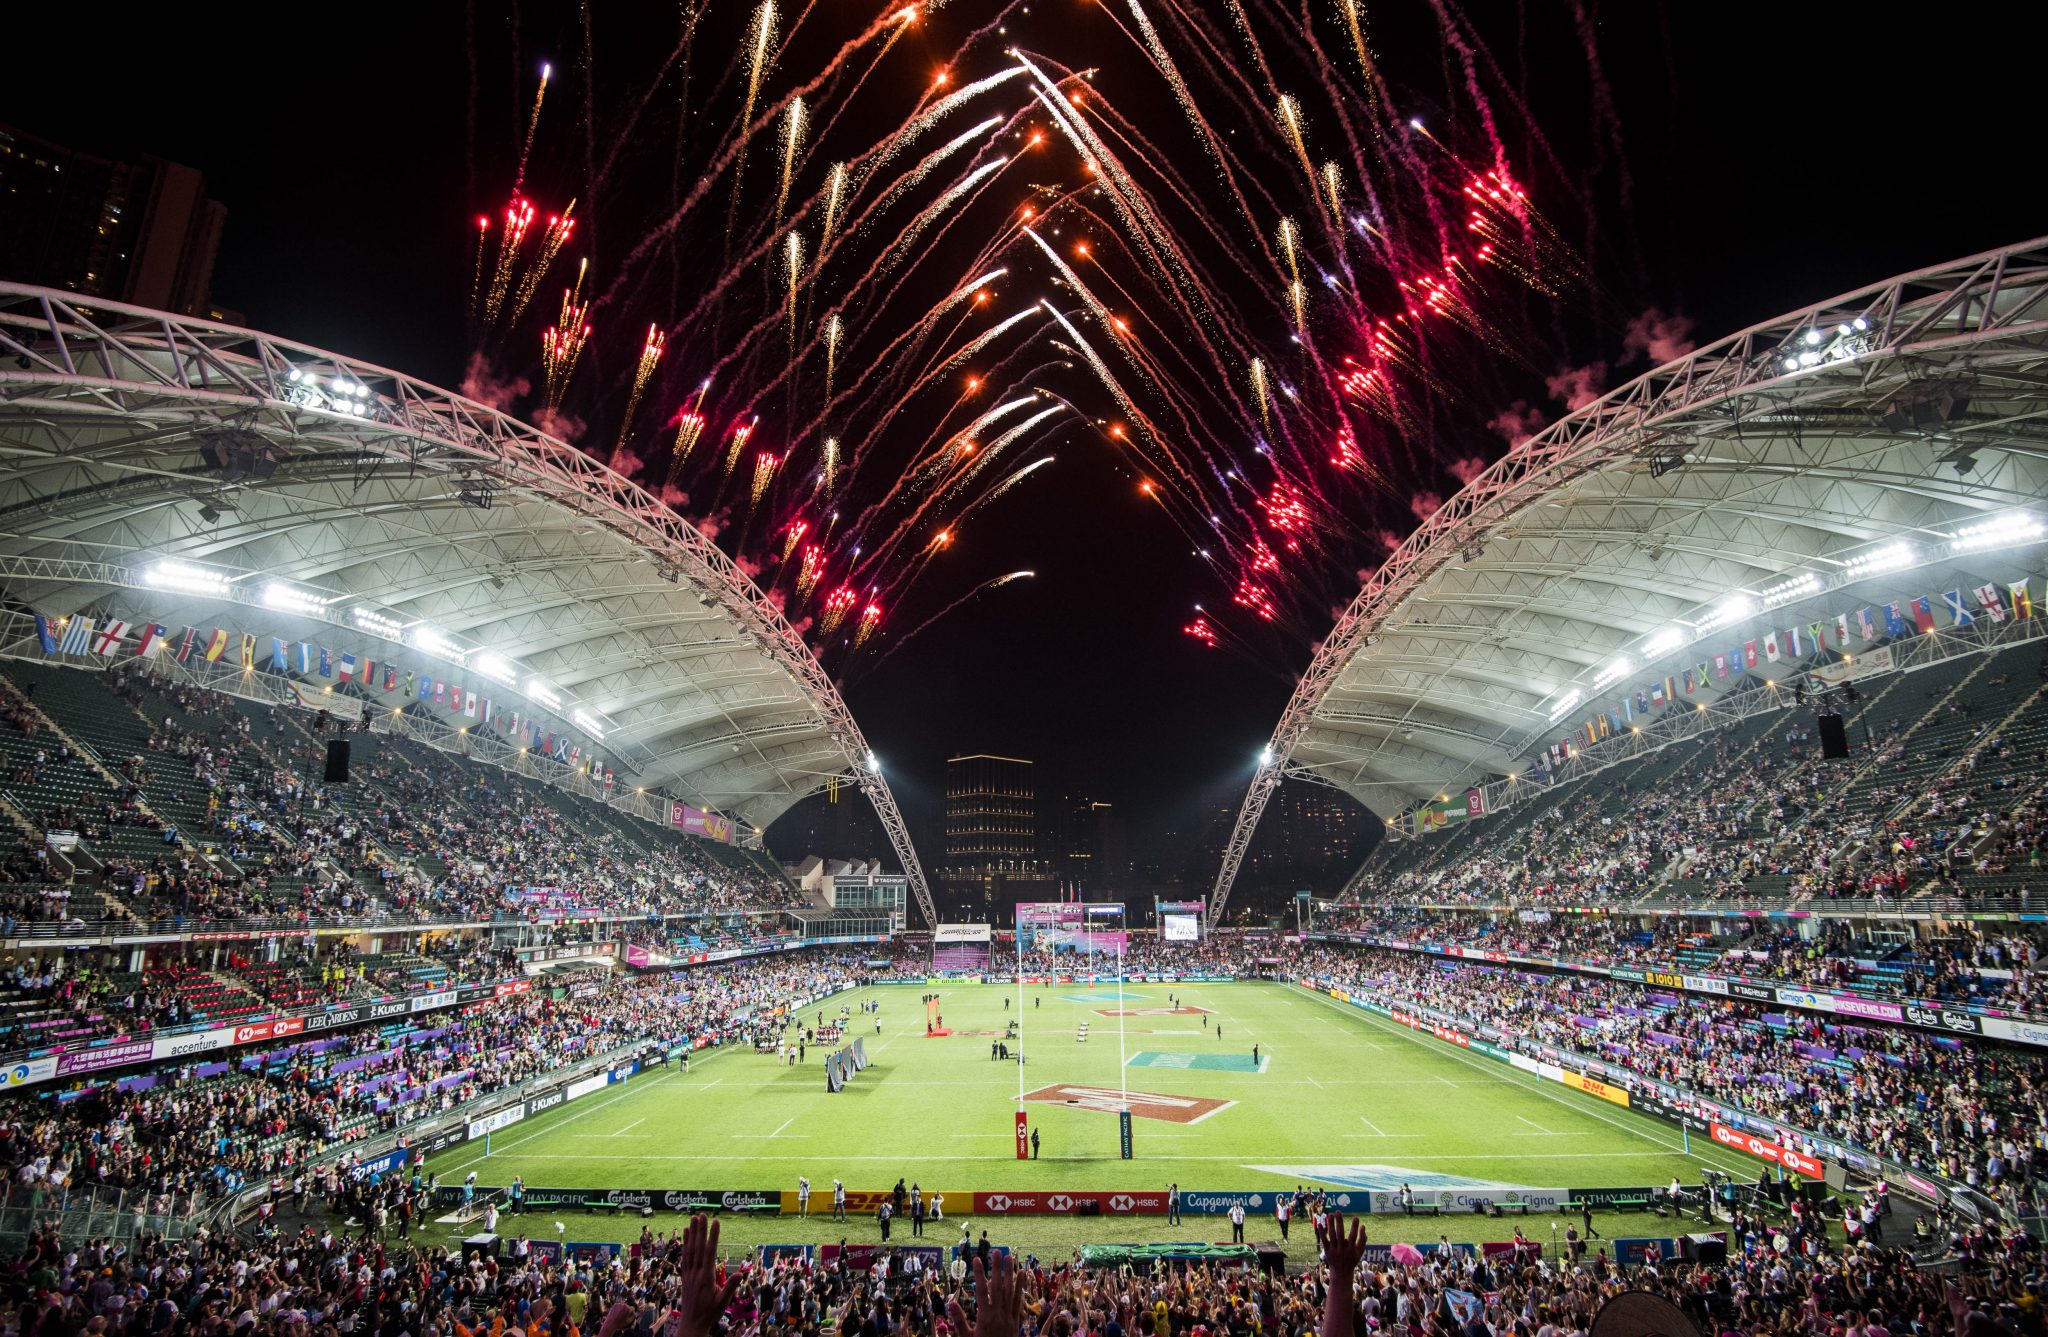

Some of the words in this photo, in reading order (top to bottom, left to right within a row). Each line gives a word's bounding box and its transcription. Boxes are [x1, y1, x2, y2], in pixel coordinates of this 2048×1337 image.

[1655, 974, 1673, 986] 1010
[1779, 991, 1804, 1004] Cimigo
[377, 1003, 406, 1017] KUKRI
[1943, 1011, 1976, 1030] Carlsberg
[171, 1035, 218, 1055] accenture
[1582, 1079, 1606, 1096] DHL
[537, 1093, 562, 1111] KUKRI
[607, 1190, 651, 1206] Carlsberg
[664, 1190, 708, 1206] Carlsberg
[722, 1191, 766, 1207] Carlsberg
[1013, 1199, 1036, 1207] HSBC
[1137, 1199, 1159, 1207] HSBC
[1187, 1193, 1249, 1212] Capgemini
[1522, 1195, 1555, 1209] Cigna
